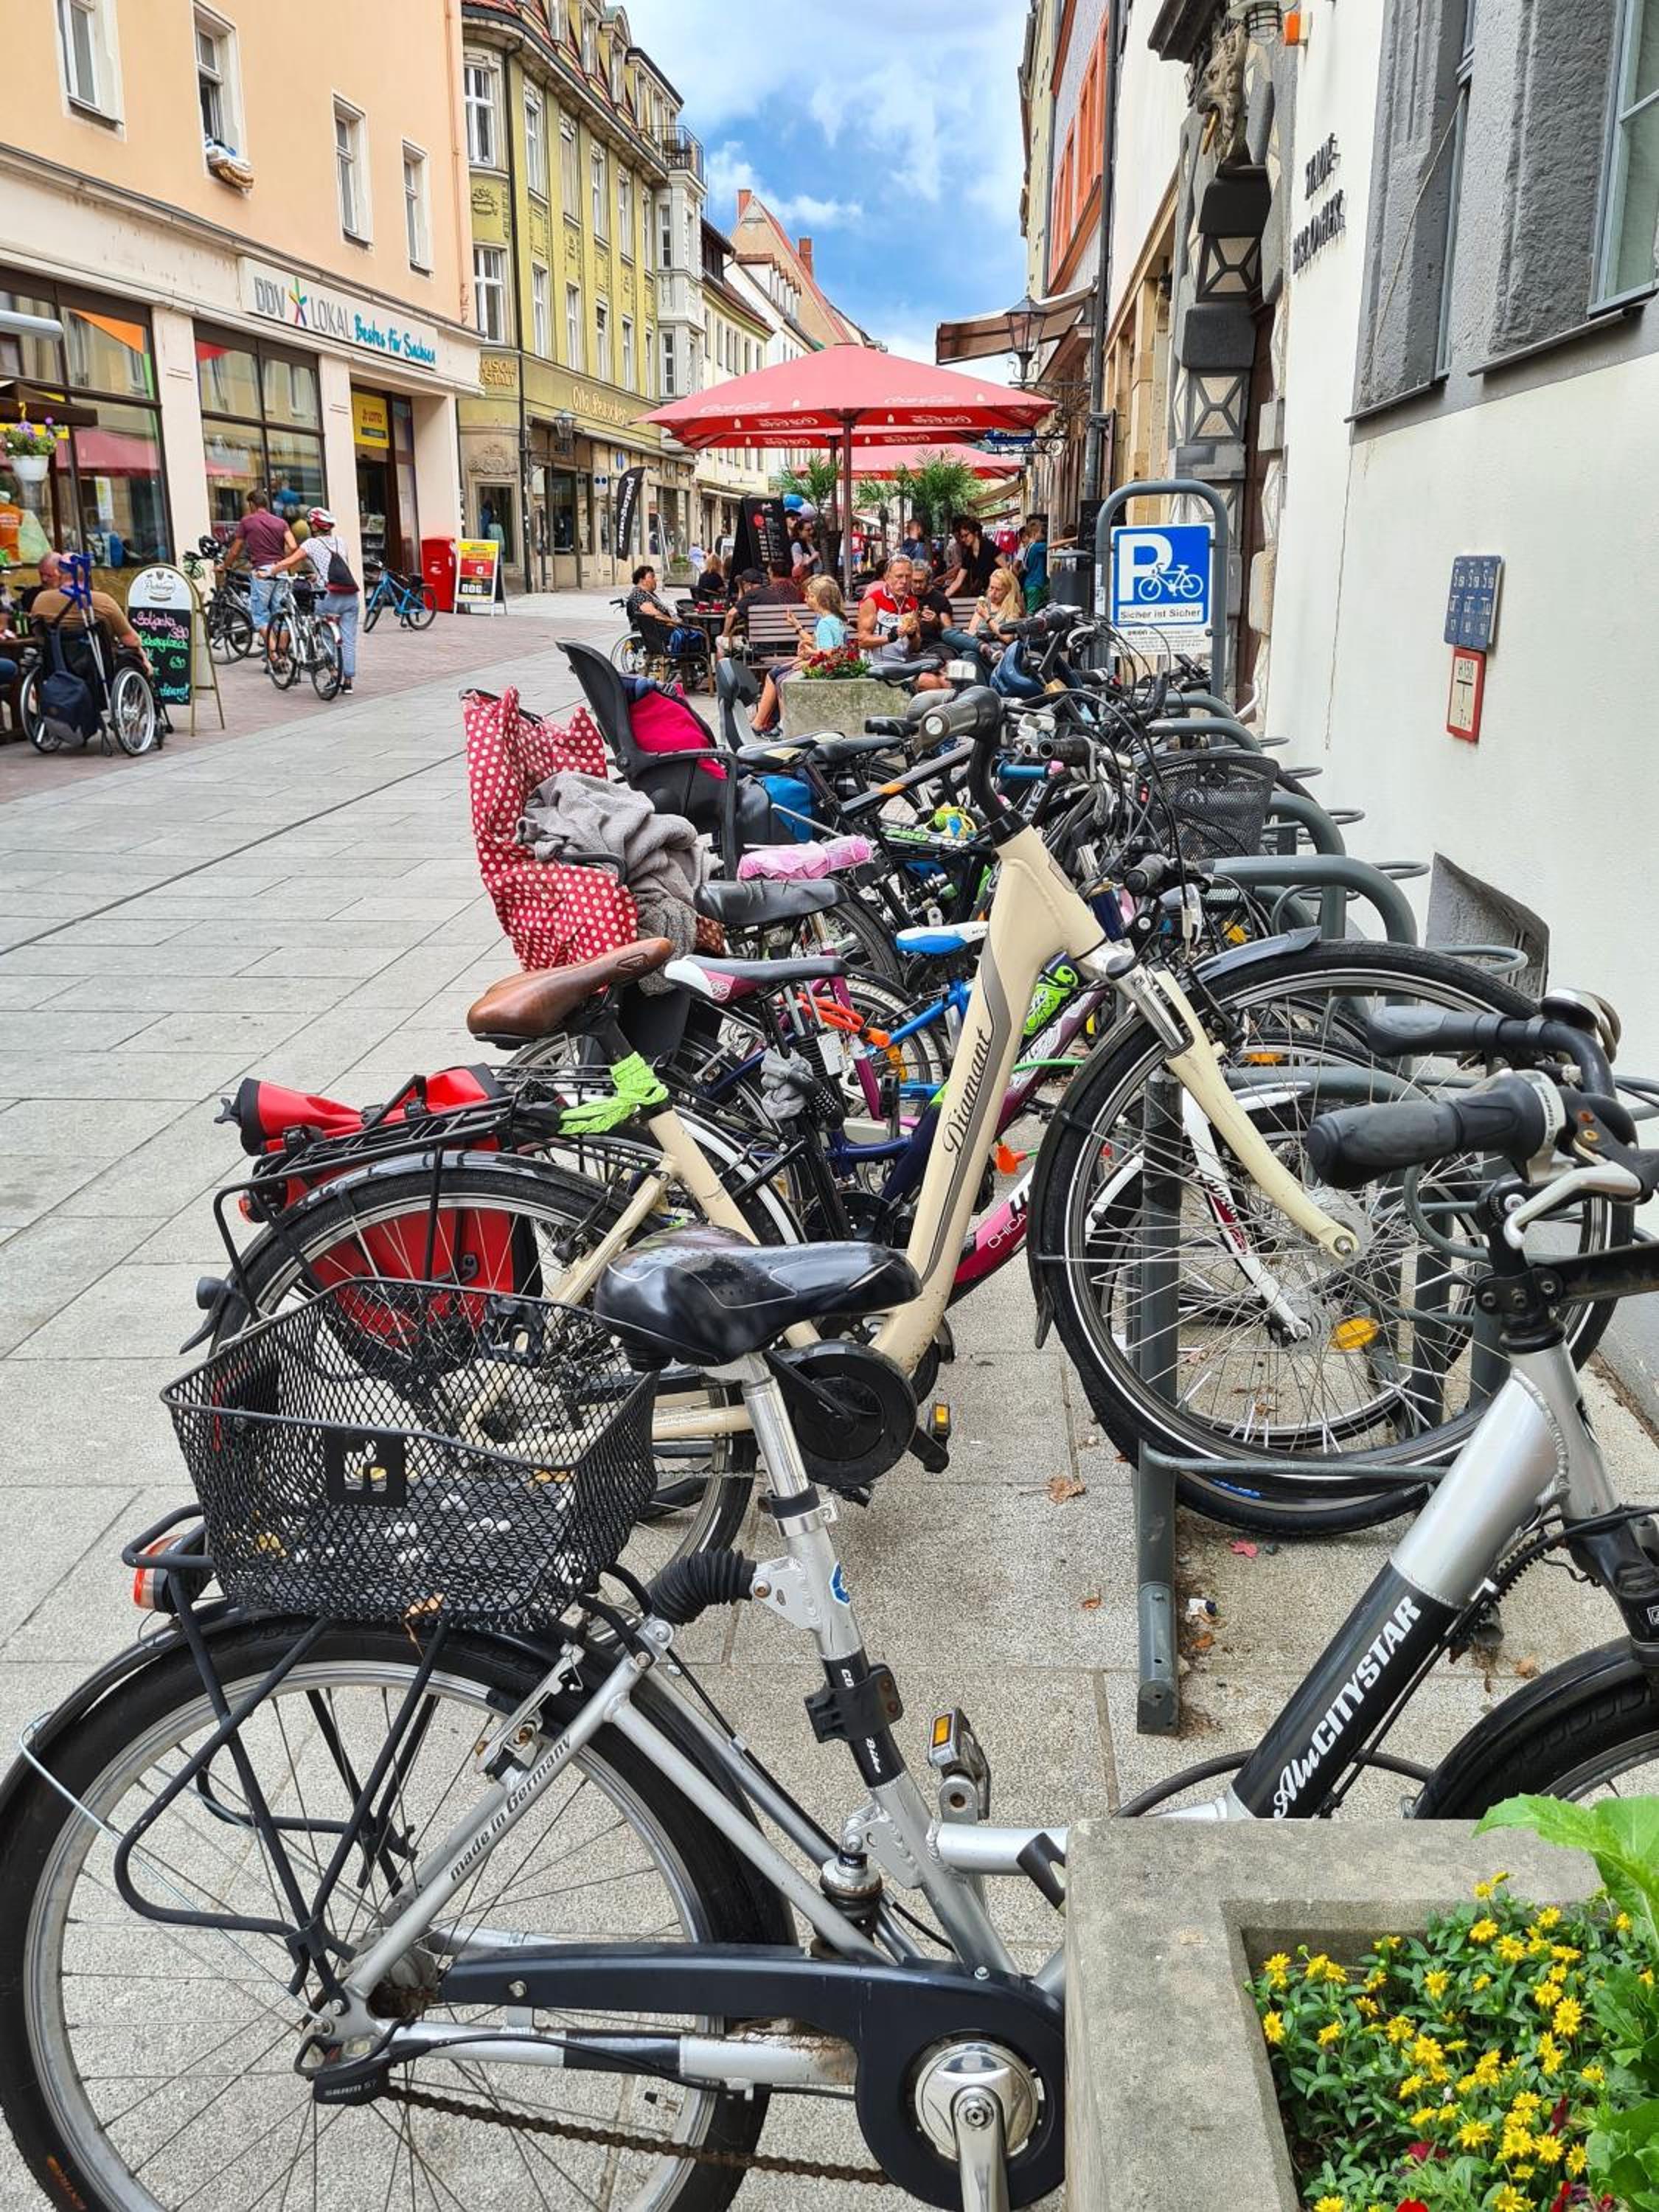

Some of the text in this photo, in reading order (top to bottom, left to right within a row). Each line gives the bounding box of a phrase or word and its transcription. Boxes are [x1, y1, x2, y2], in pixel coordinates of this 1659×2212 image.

[254, 277, 285, 319] DDV
[310, 298, 352, 340] LOKAL
[403, 333, 437, 364] Sachsen
[1118, 533, 1173, 602] P
[1120, 608, 1200, 619] Sicher ist Sicher
[943, 1026, 991, 1153] Diamant
[1311, 1596, 1422, 1748] CITYSTAR
[450, 1733, 571, 1882] made in Germany
